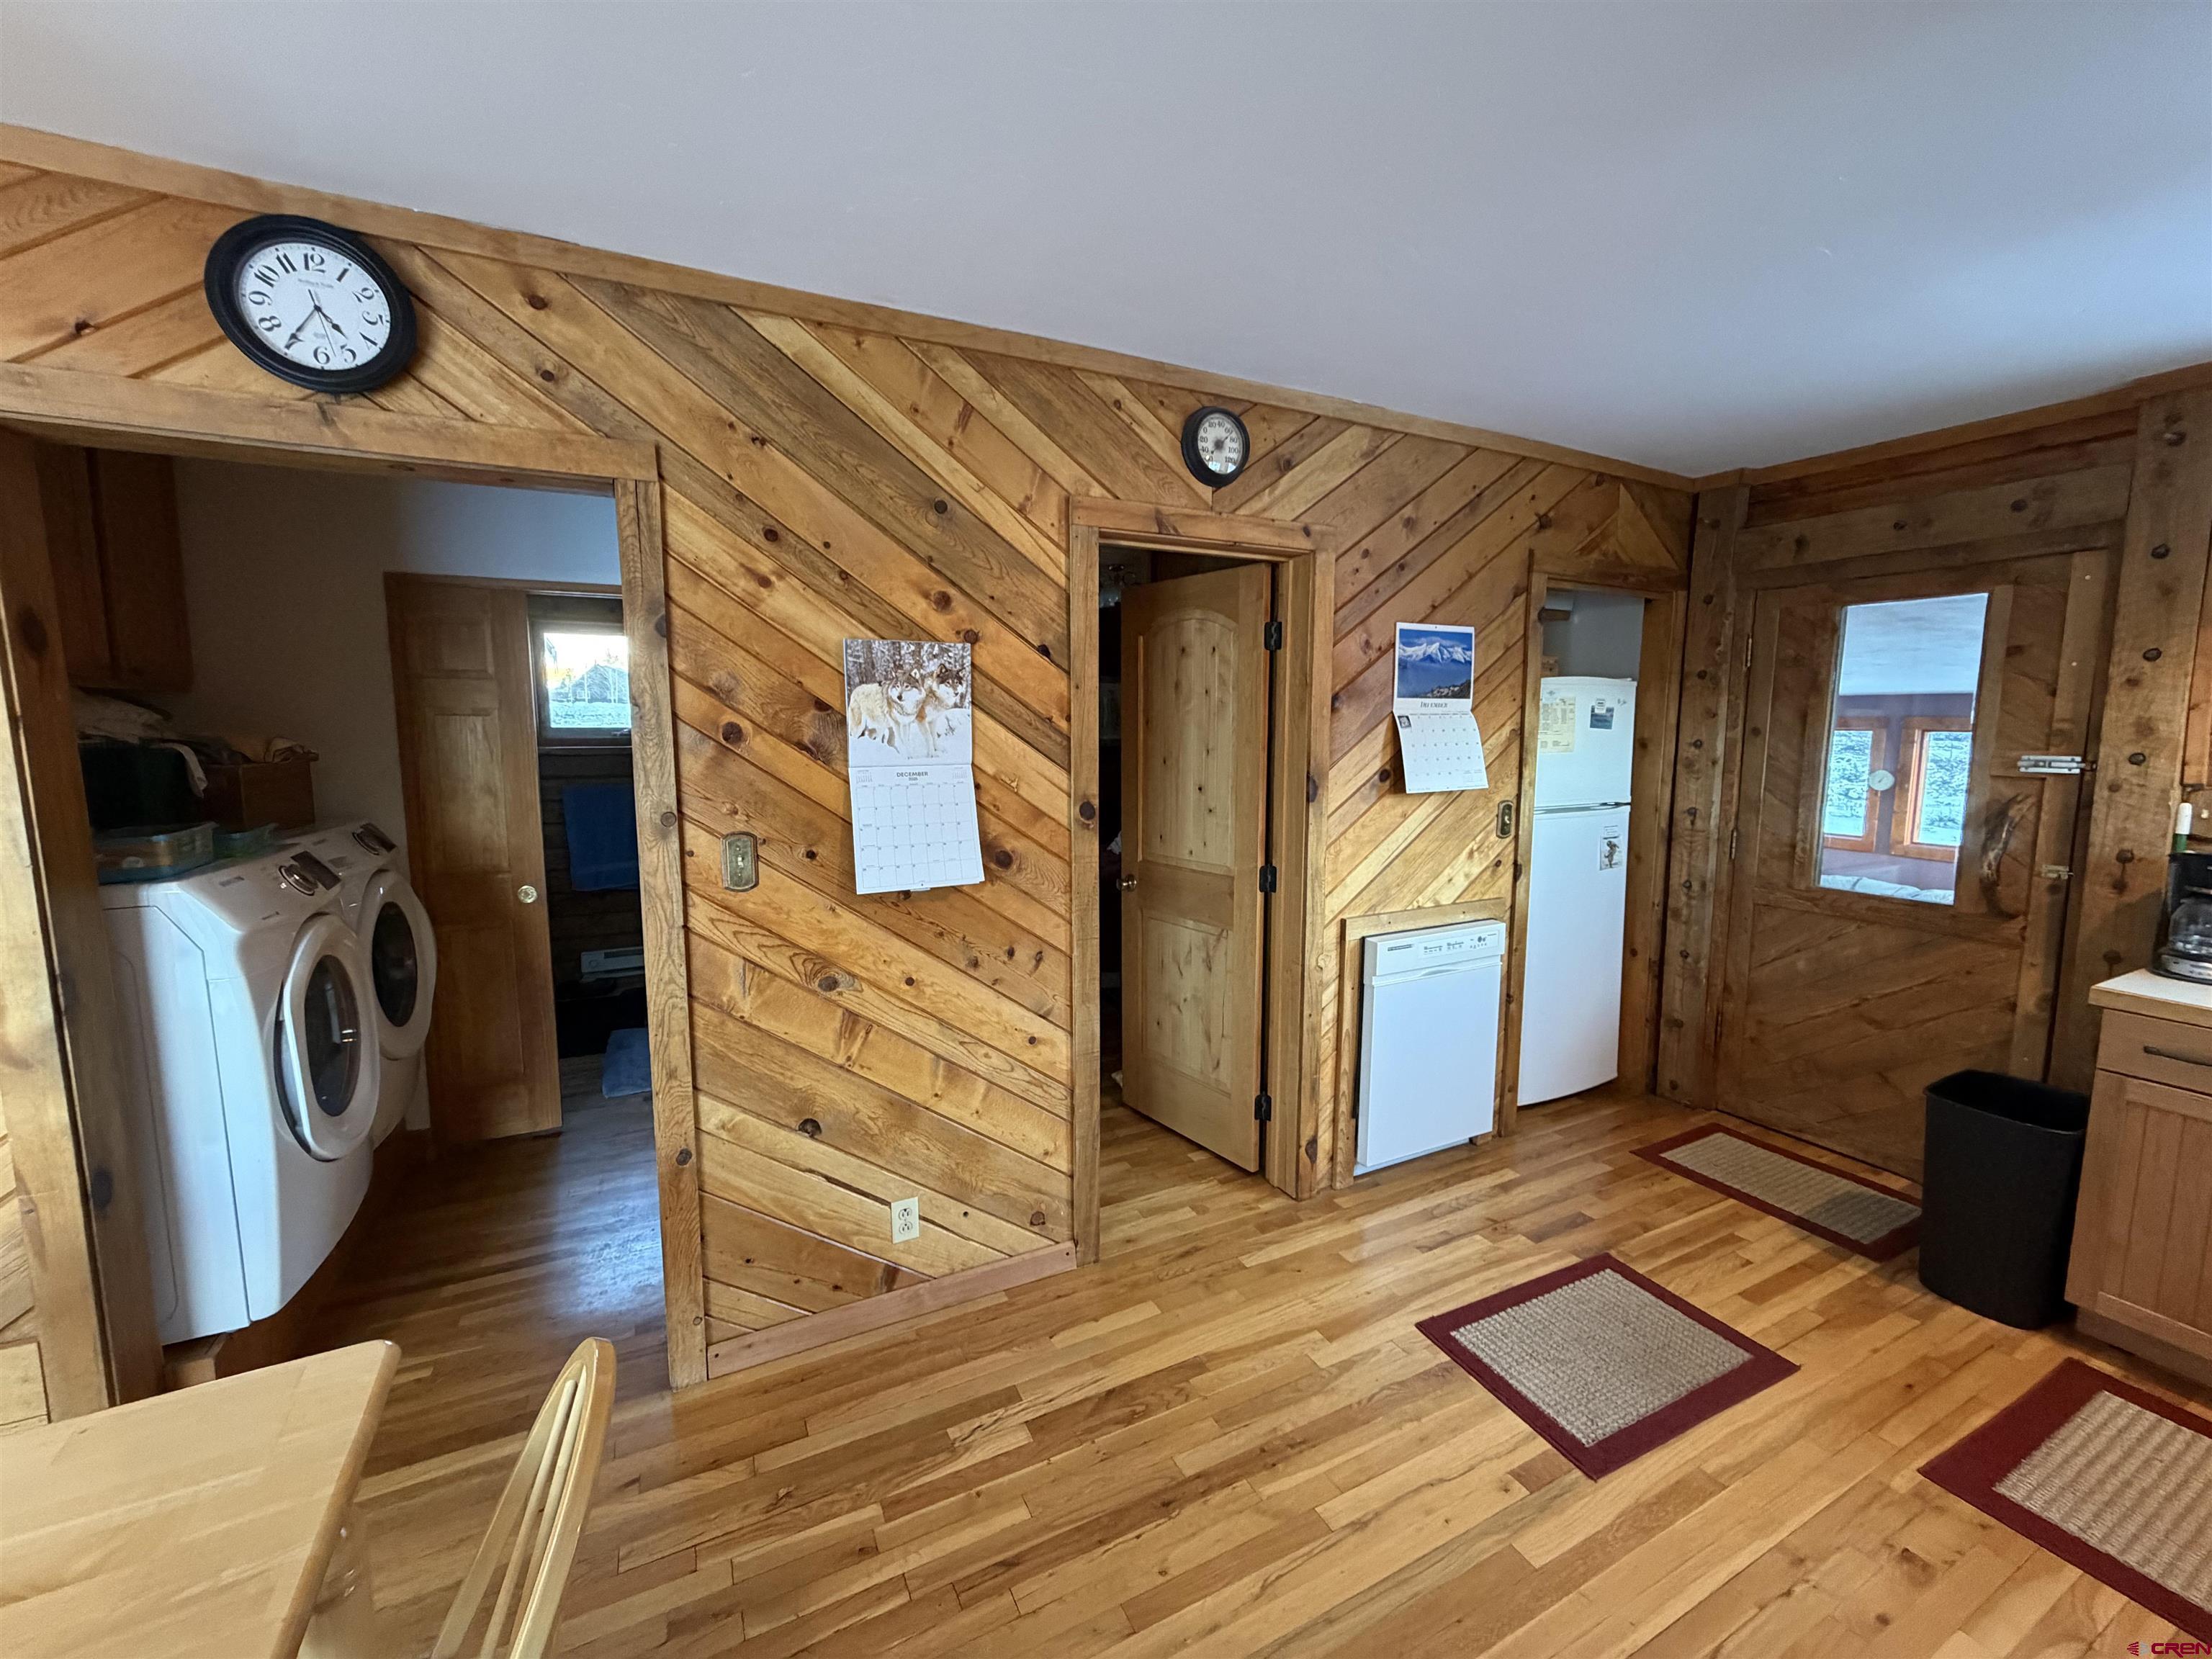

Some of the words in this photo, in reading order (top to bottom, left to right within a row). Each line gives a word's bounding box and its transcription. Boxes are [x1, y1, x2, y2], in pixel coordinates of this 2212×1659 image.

[276, 253, 297, 274] 11
[303, 253, 326, 273] 12
[253, 265, 280, 288] 10
[336, 268, 349, 282] 1
[248, 290, 271, 306] 9
[352, 288, 374, 303] 2
[258, 315, 282, 332] 8
[361, 310, 385, 326] 3
[313, 346, 330, 364] 6
[340, 343, 357, 363] 5
